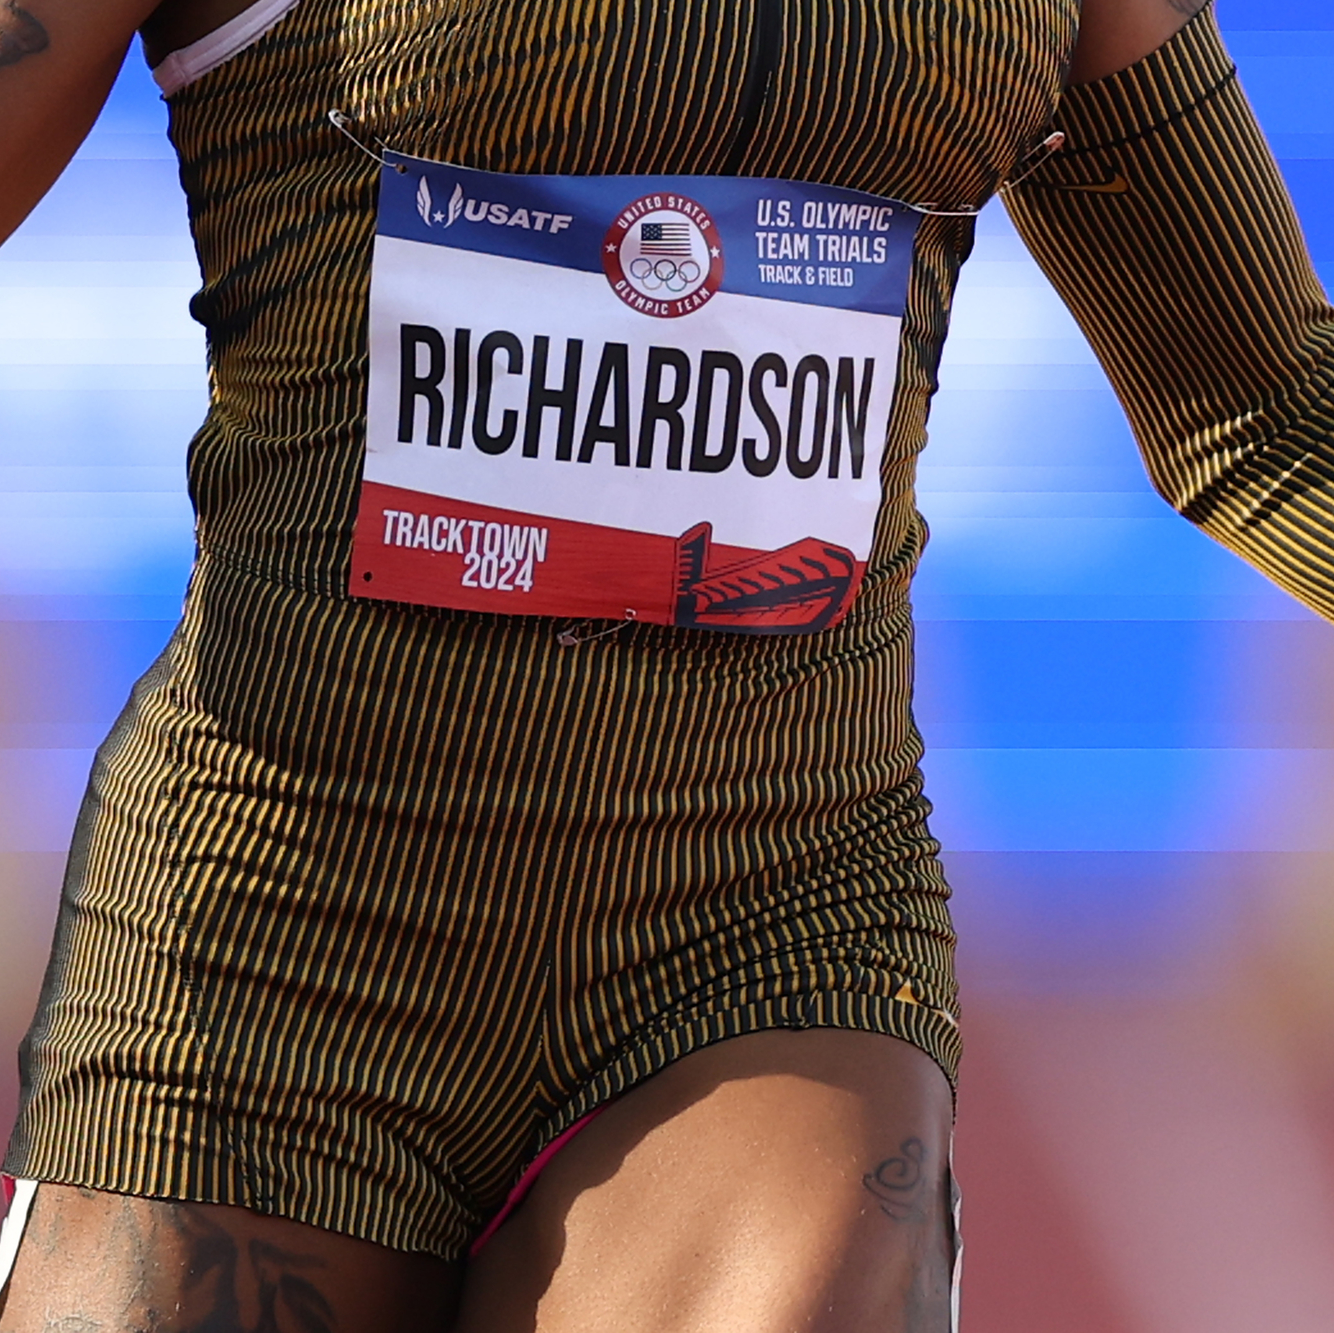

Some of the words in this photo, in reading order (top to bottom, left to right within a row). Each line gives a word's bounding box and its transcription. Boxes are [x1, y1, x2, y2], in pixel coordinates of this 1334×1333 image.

[464, 199, 572, 234] USATF
[617, 196, 662, 229] UNITED
[668, 196, 711, 230] STATES
[757, 199, 795, 228] U.S.
[802, 201, 893, 231] OLYMPIC
[755, 232, 809, 260] TEAM
[815, 234, 887, 264] TRIALS
[758, 264, 802, 285] TRACK
[805, 266, 815, 285] &
[819, 267, 854, 287] FIELD
[615, 280, 668, 315] OLYMPIC
[676, 287, 710, 313] TEAM
[396, 322, 875, 480] RICHARDSON
[383, 510, 548, 562] TRACKTOWN
[462, 552, 533, 592] 2024
